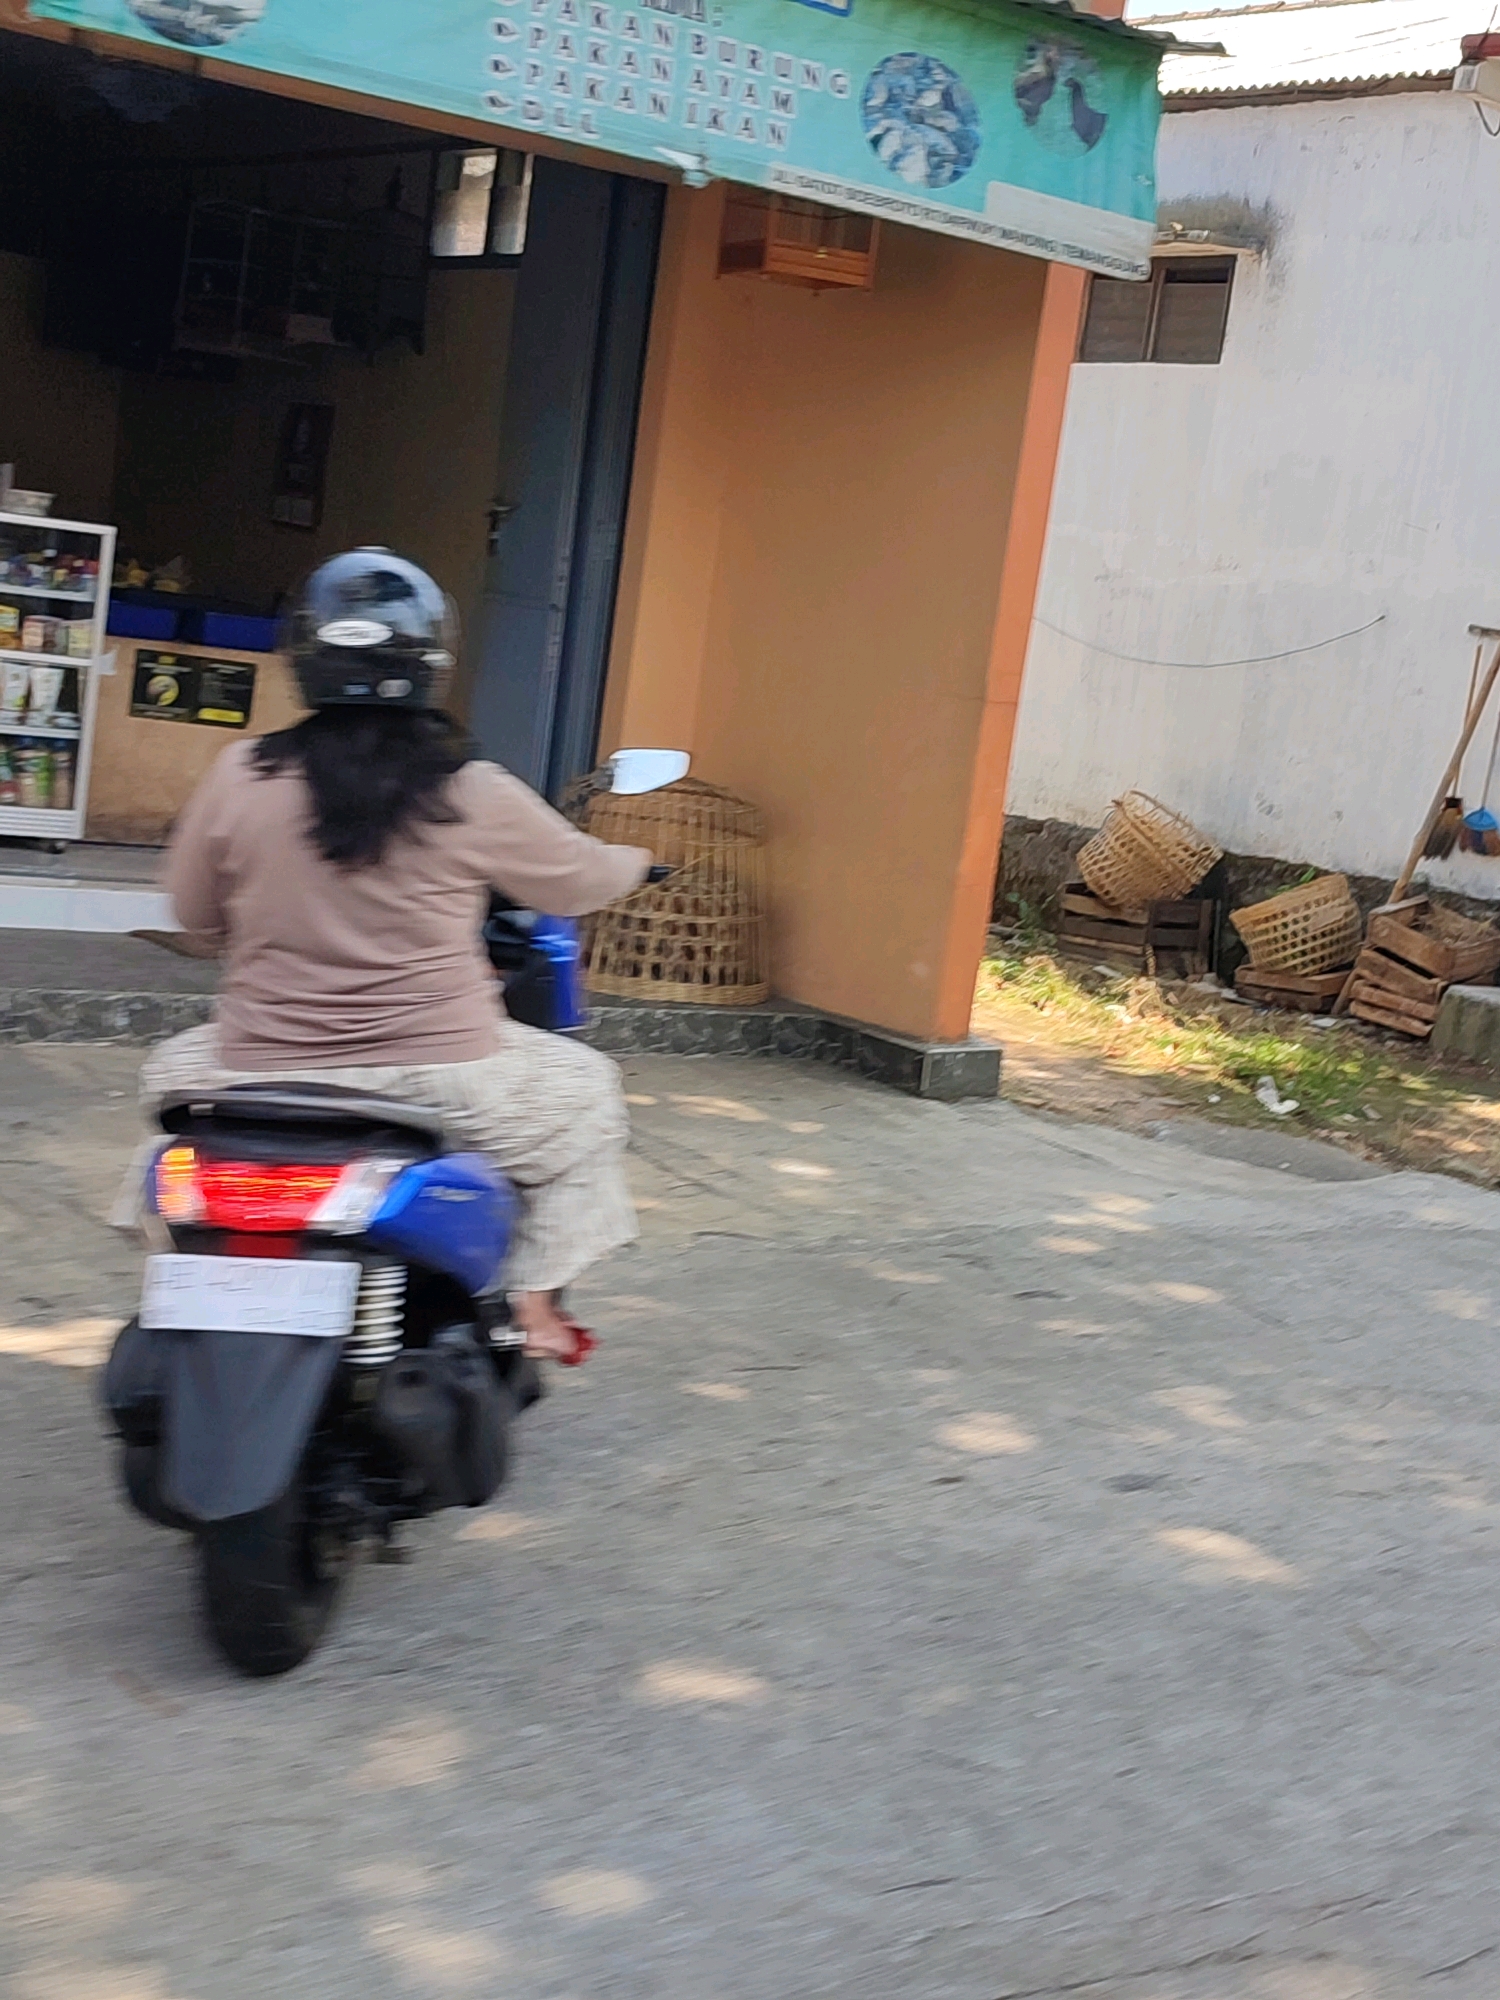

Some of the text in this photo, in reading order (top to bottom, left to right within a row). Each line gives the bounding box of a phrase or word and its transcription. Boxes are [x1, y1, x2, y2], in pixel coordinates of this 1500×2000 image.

[526, 25, 797, 116] PAKAN AYAM
[530, 0, 677, 48] PAKAN
[689, 31, 850, 97] BURUNG
[521, 97, 599, 137] DLL
[523, 61, 789, 146] PAKAN IKAN
